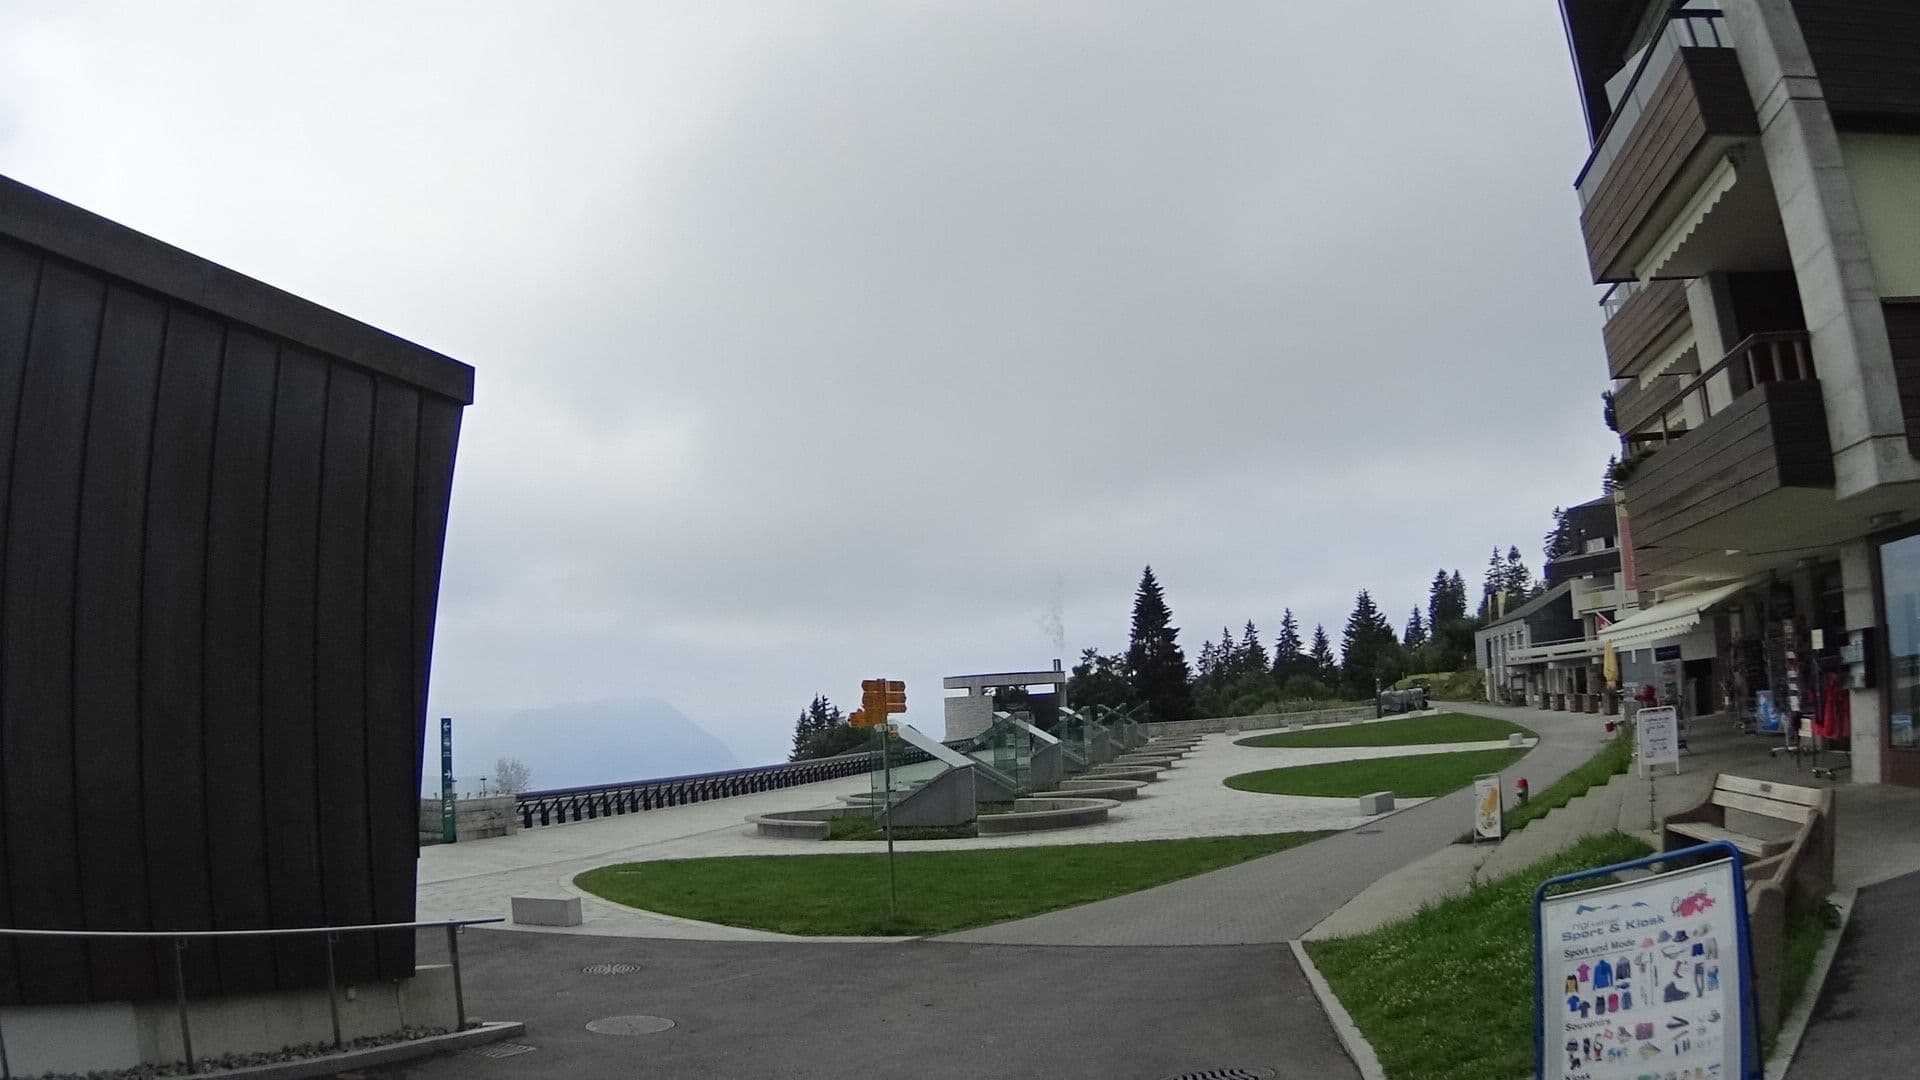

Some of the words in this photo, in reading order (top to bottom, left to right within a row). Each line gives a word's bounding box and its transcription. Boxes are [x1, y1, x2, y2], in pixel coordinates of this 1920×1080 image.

[1561, 927, 1604, 942] Sport
[1609, 922, 1620, 934] &
[1626, 914, 1664, 930] Kiosk
[1563, 946, 1589, 960] Sport
[1591, 943, 1608, 954] und
[1611, 939, 1636, 950] Mode
